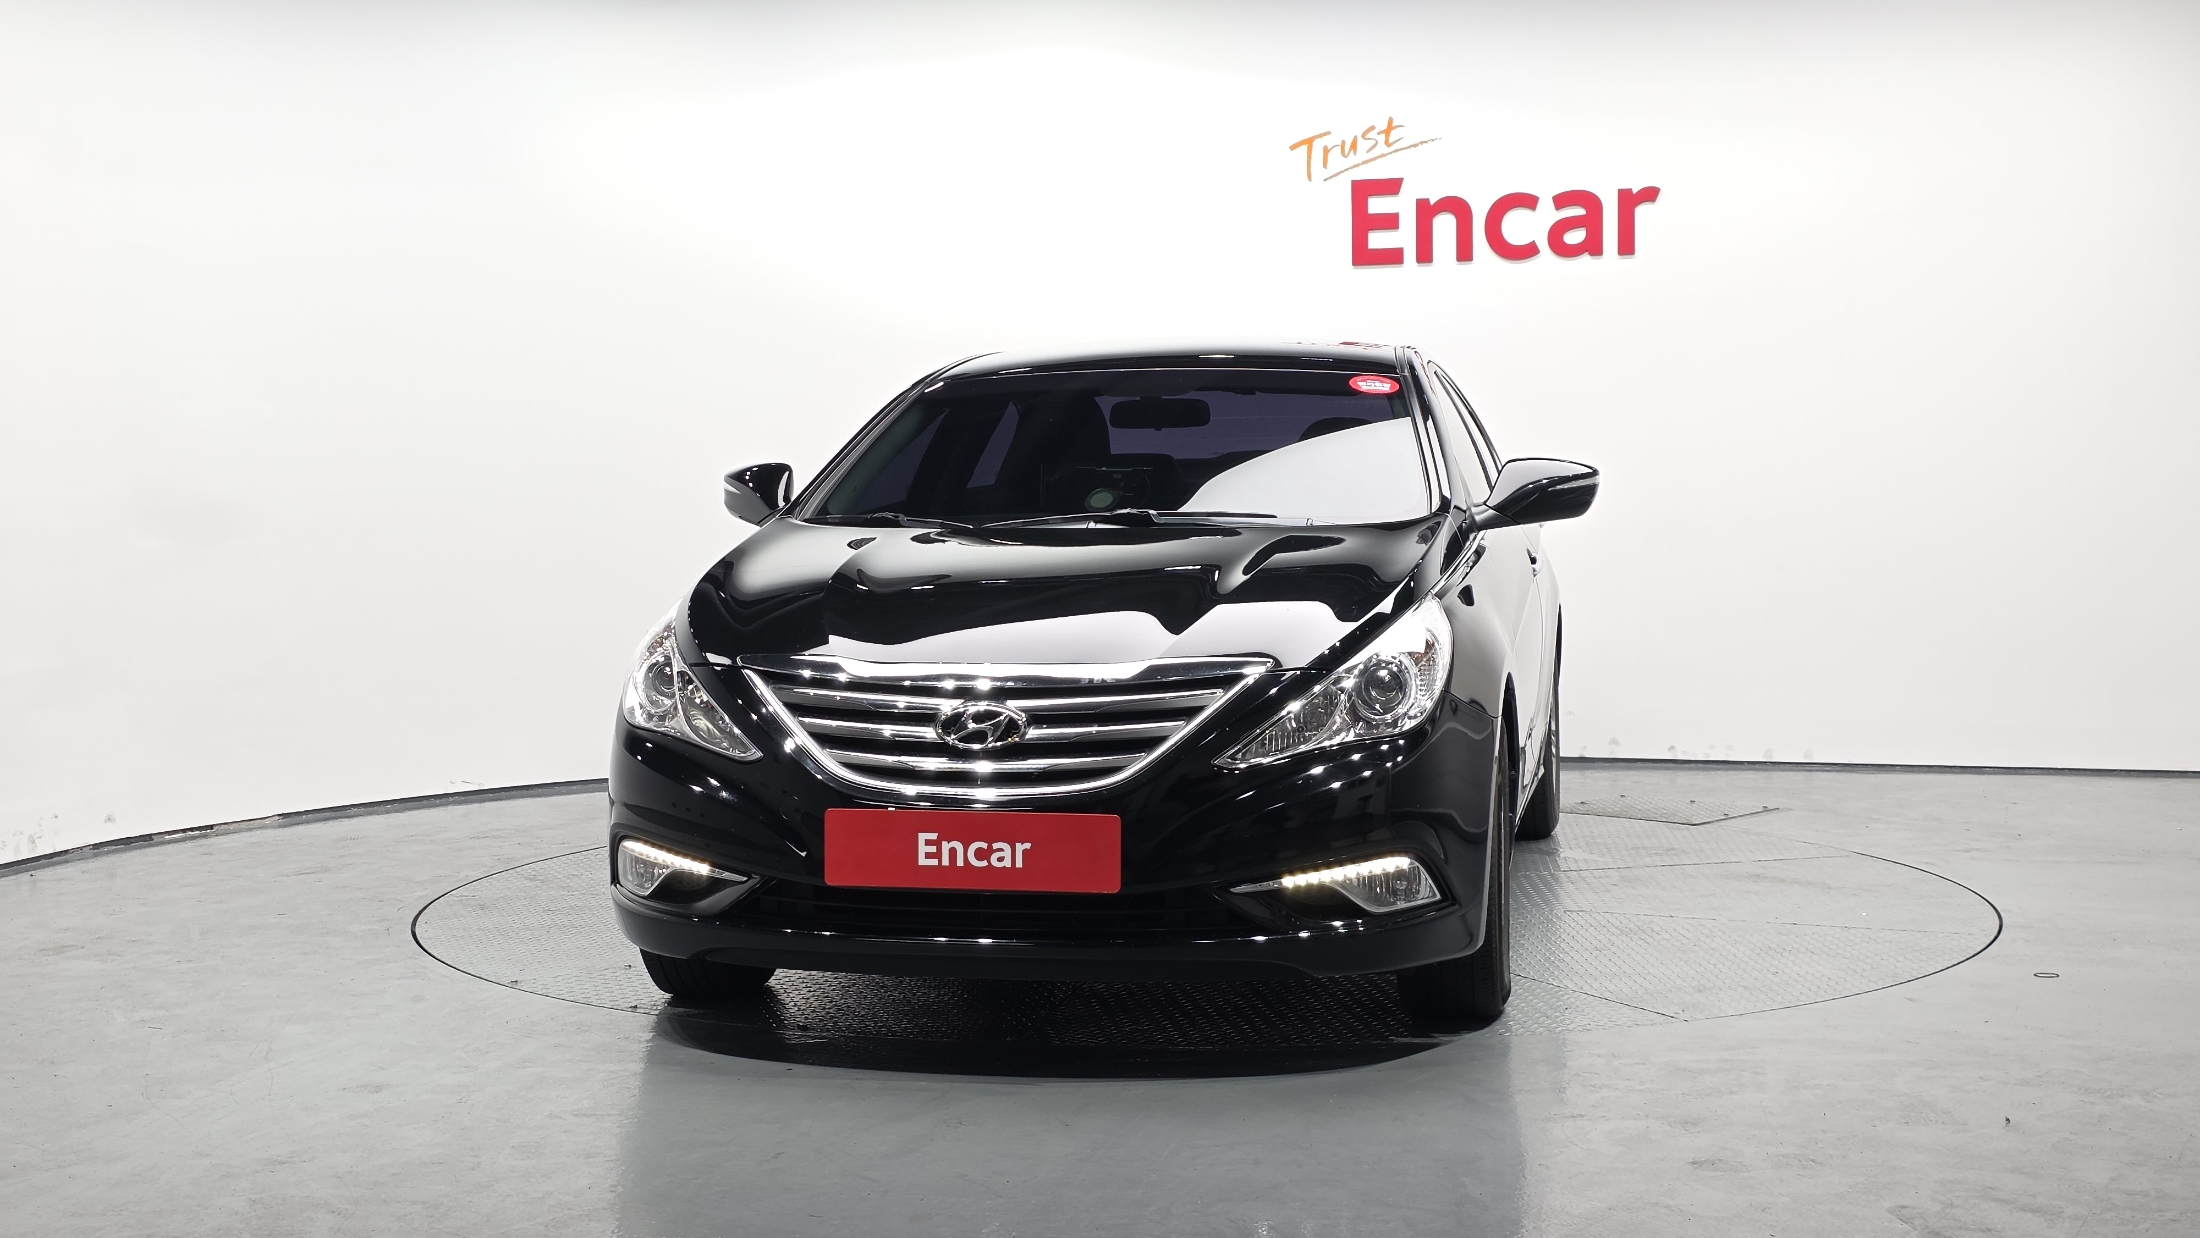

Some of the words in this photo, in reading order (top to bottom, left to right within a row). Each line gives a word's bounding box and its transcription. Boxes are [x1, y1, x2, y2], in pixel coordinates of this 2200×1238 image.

[1289, 116, 1404, 182] Trust
[1351, 178, 1660, 267] Encar
[917, 832, 1032, 868] Encar
